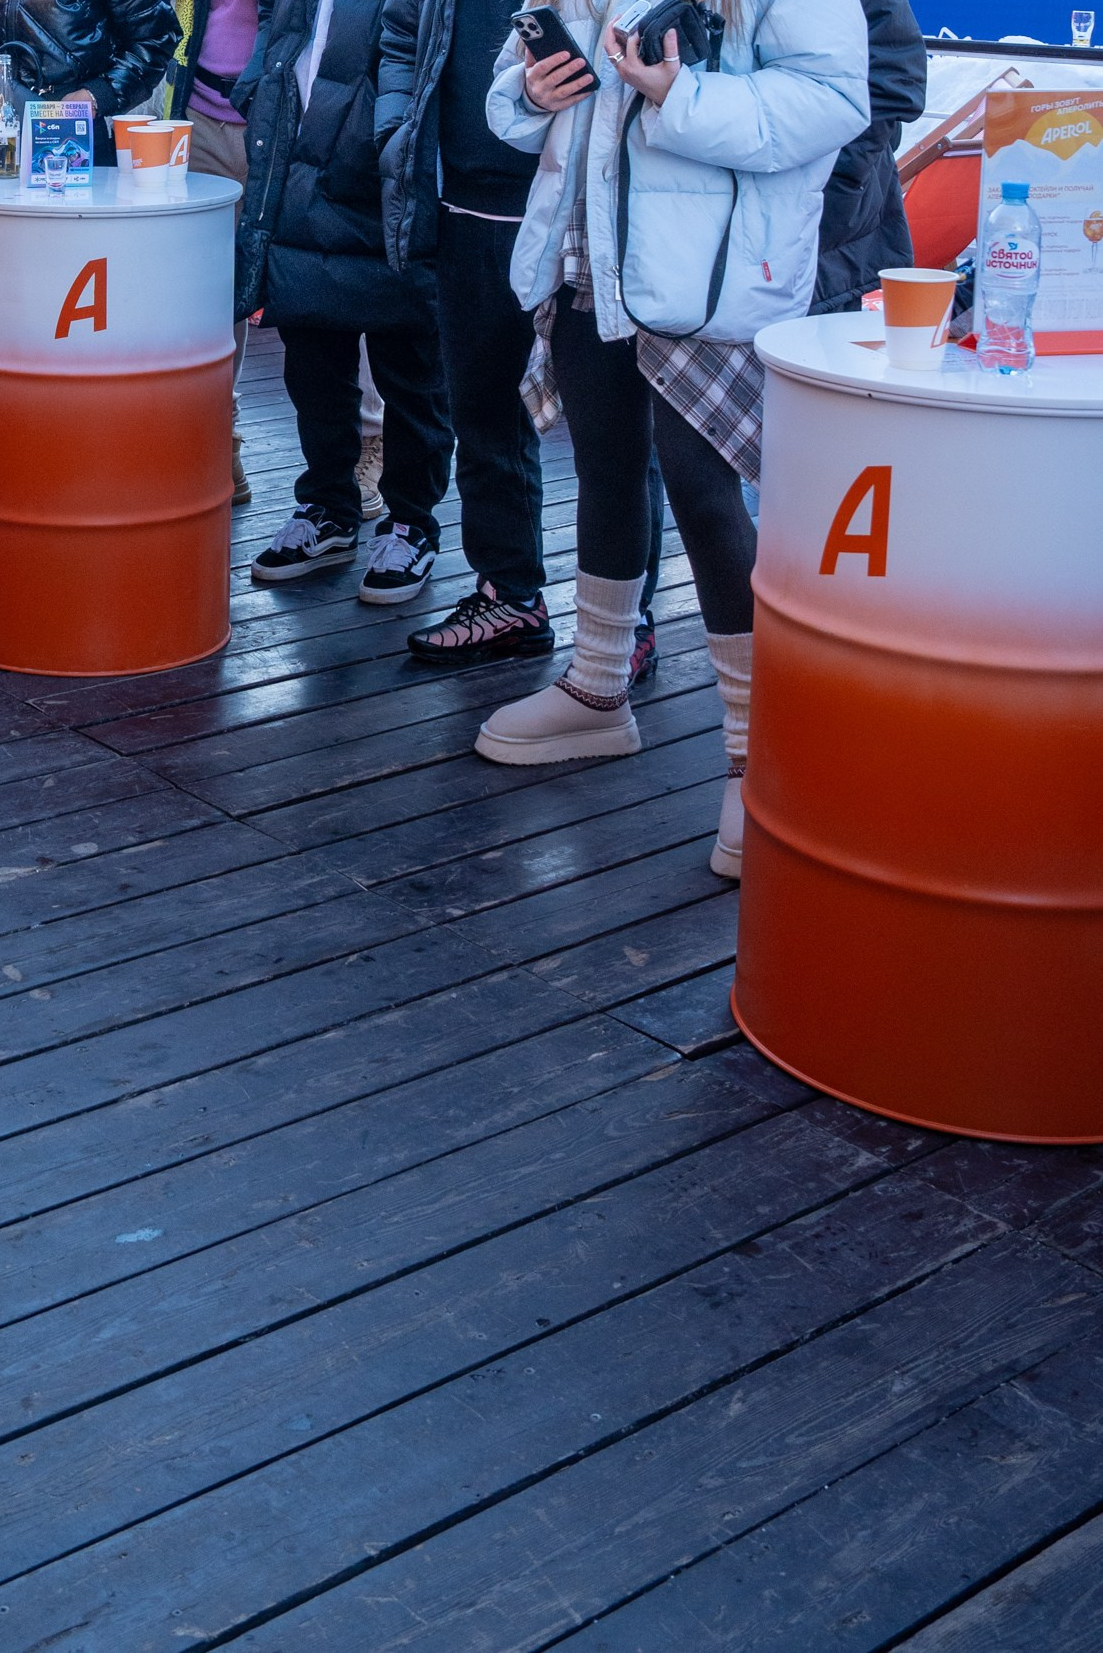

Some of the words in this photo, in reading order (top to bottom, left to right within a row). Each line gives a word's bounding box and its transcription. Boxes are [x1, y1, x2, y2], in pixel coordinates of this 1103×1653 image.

[30, 110, 54, 118] ВМЕСТЕ
[55, 110, 64, 118] НА
[65, 110, 89, 118] ВЫСОТЕ
[1030, 103, 1054, 114] ГОРЫ
[1055, 96, 1081, 109] ЗОВУТ
[1040, 120, 1093, 146] APEROL
[55, 257, 107, 339] A
[819, 465, 893, 577] A
